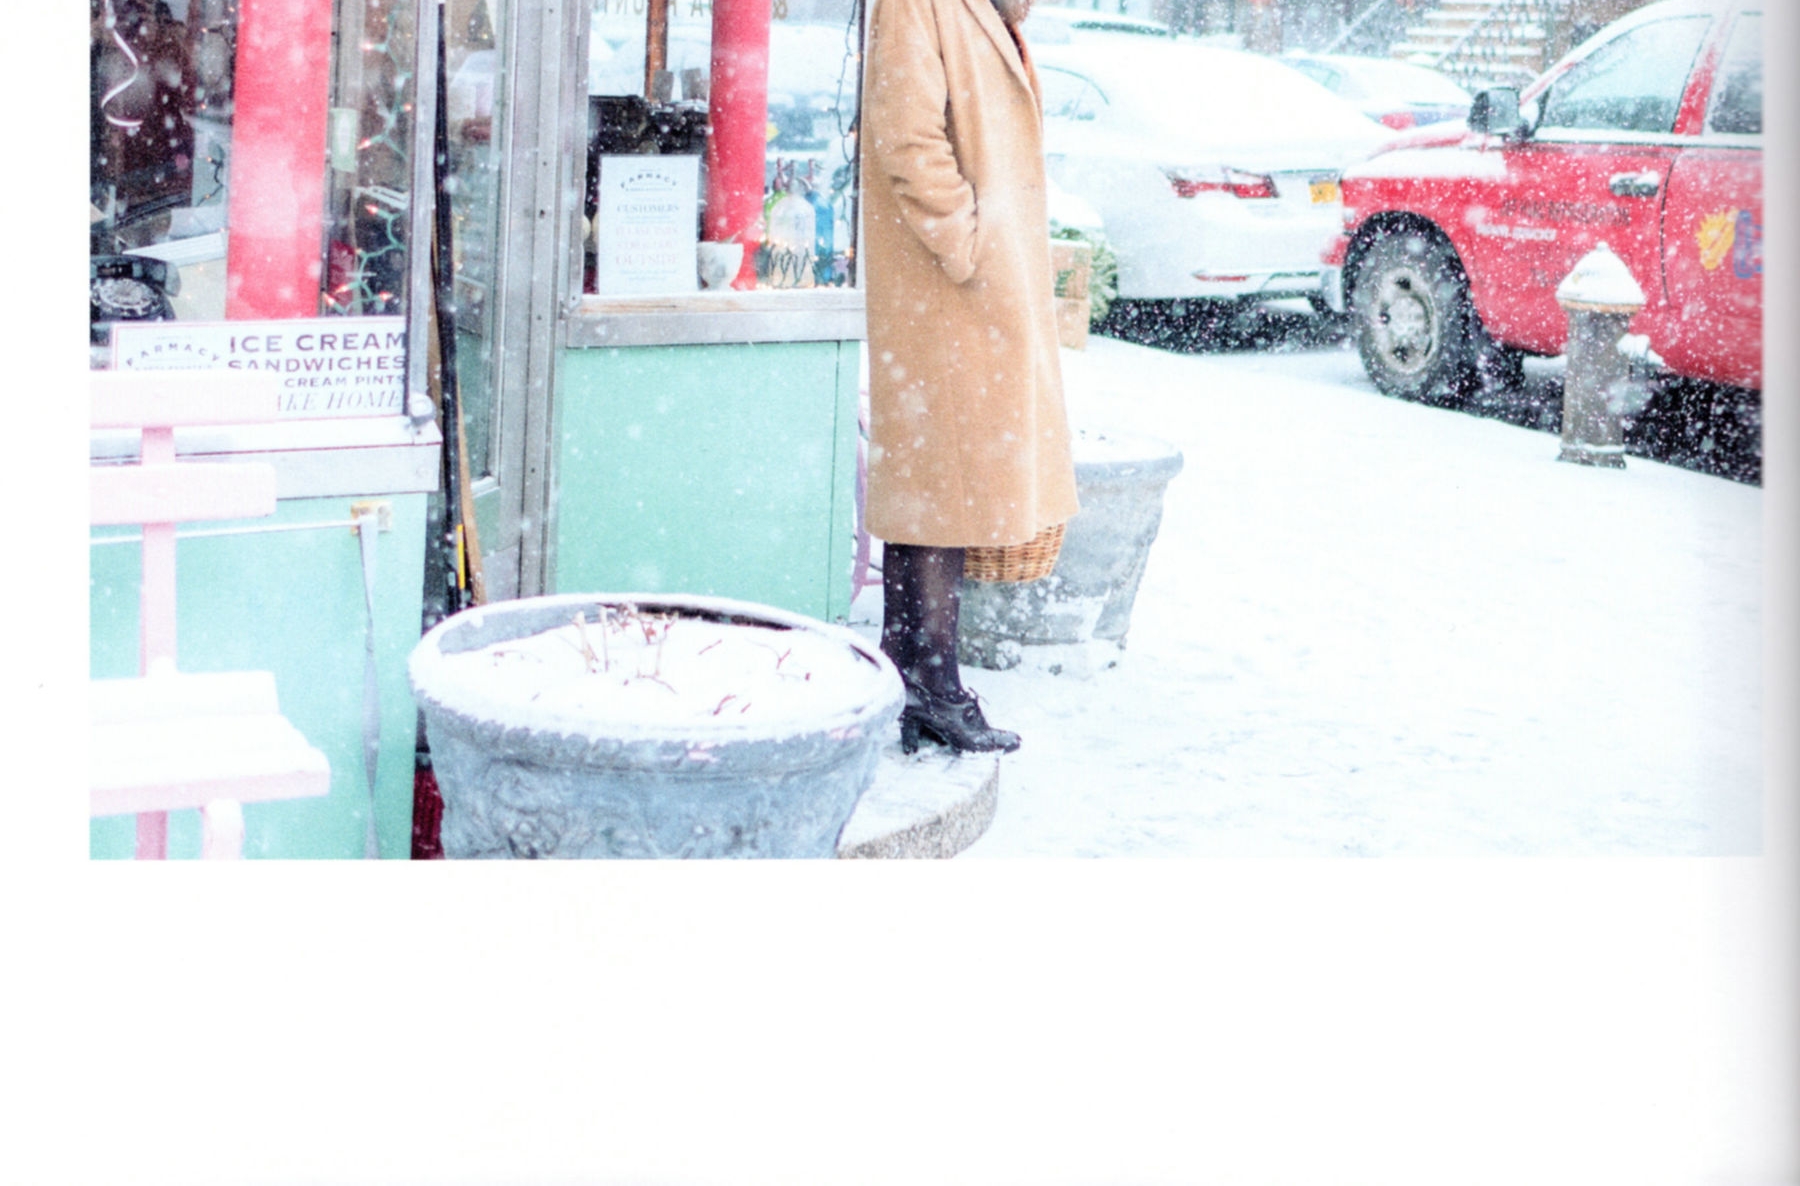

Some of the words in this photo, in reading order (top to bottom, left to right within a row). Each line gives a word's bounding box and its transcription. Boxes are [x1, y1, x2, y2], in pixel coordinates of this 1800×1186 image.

[229, 334, 284, 354] ICE
[295, 332, 405, 352] CREAM
[227, 354, 405, 373] SANDWICHES
[284, 376, 348, 389] CREAM
[354, 374, 404, 387] PINTS
[326, 389, 402, 411] HOME
